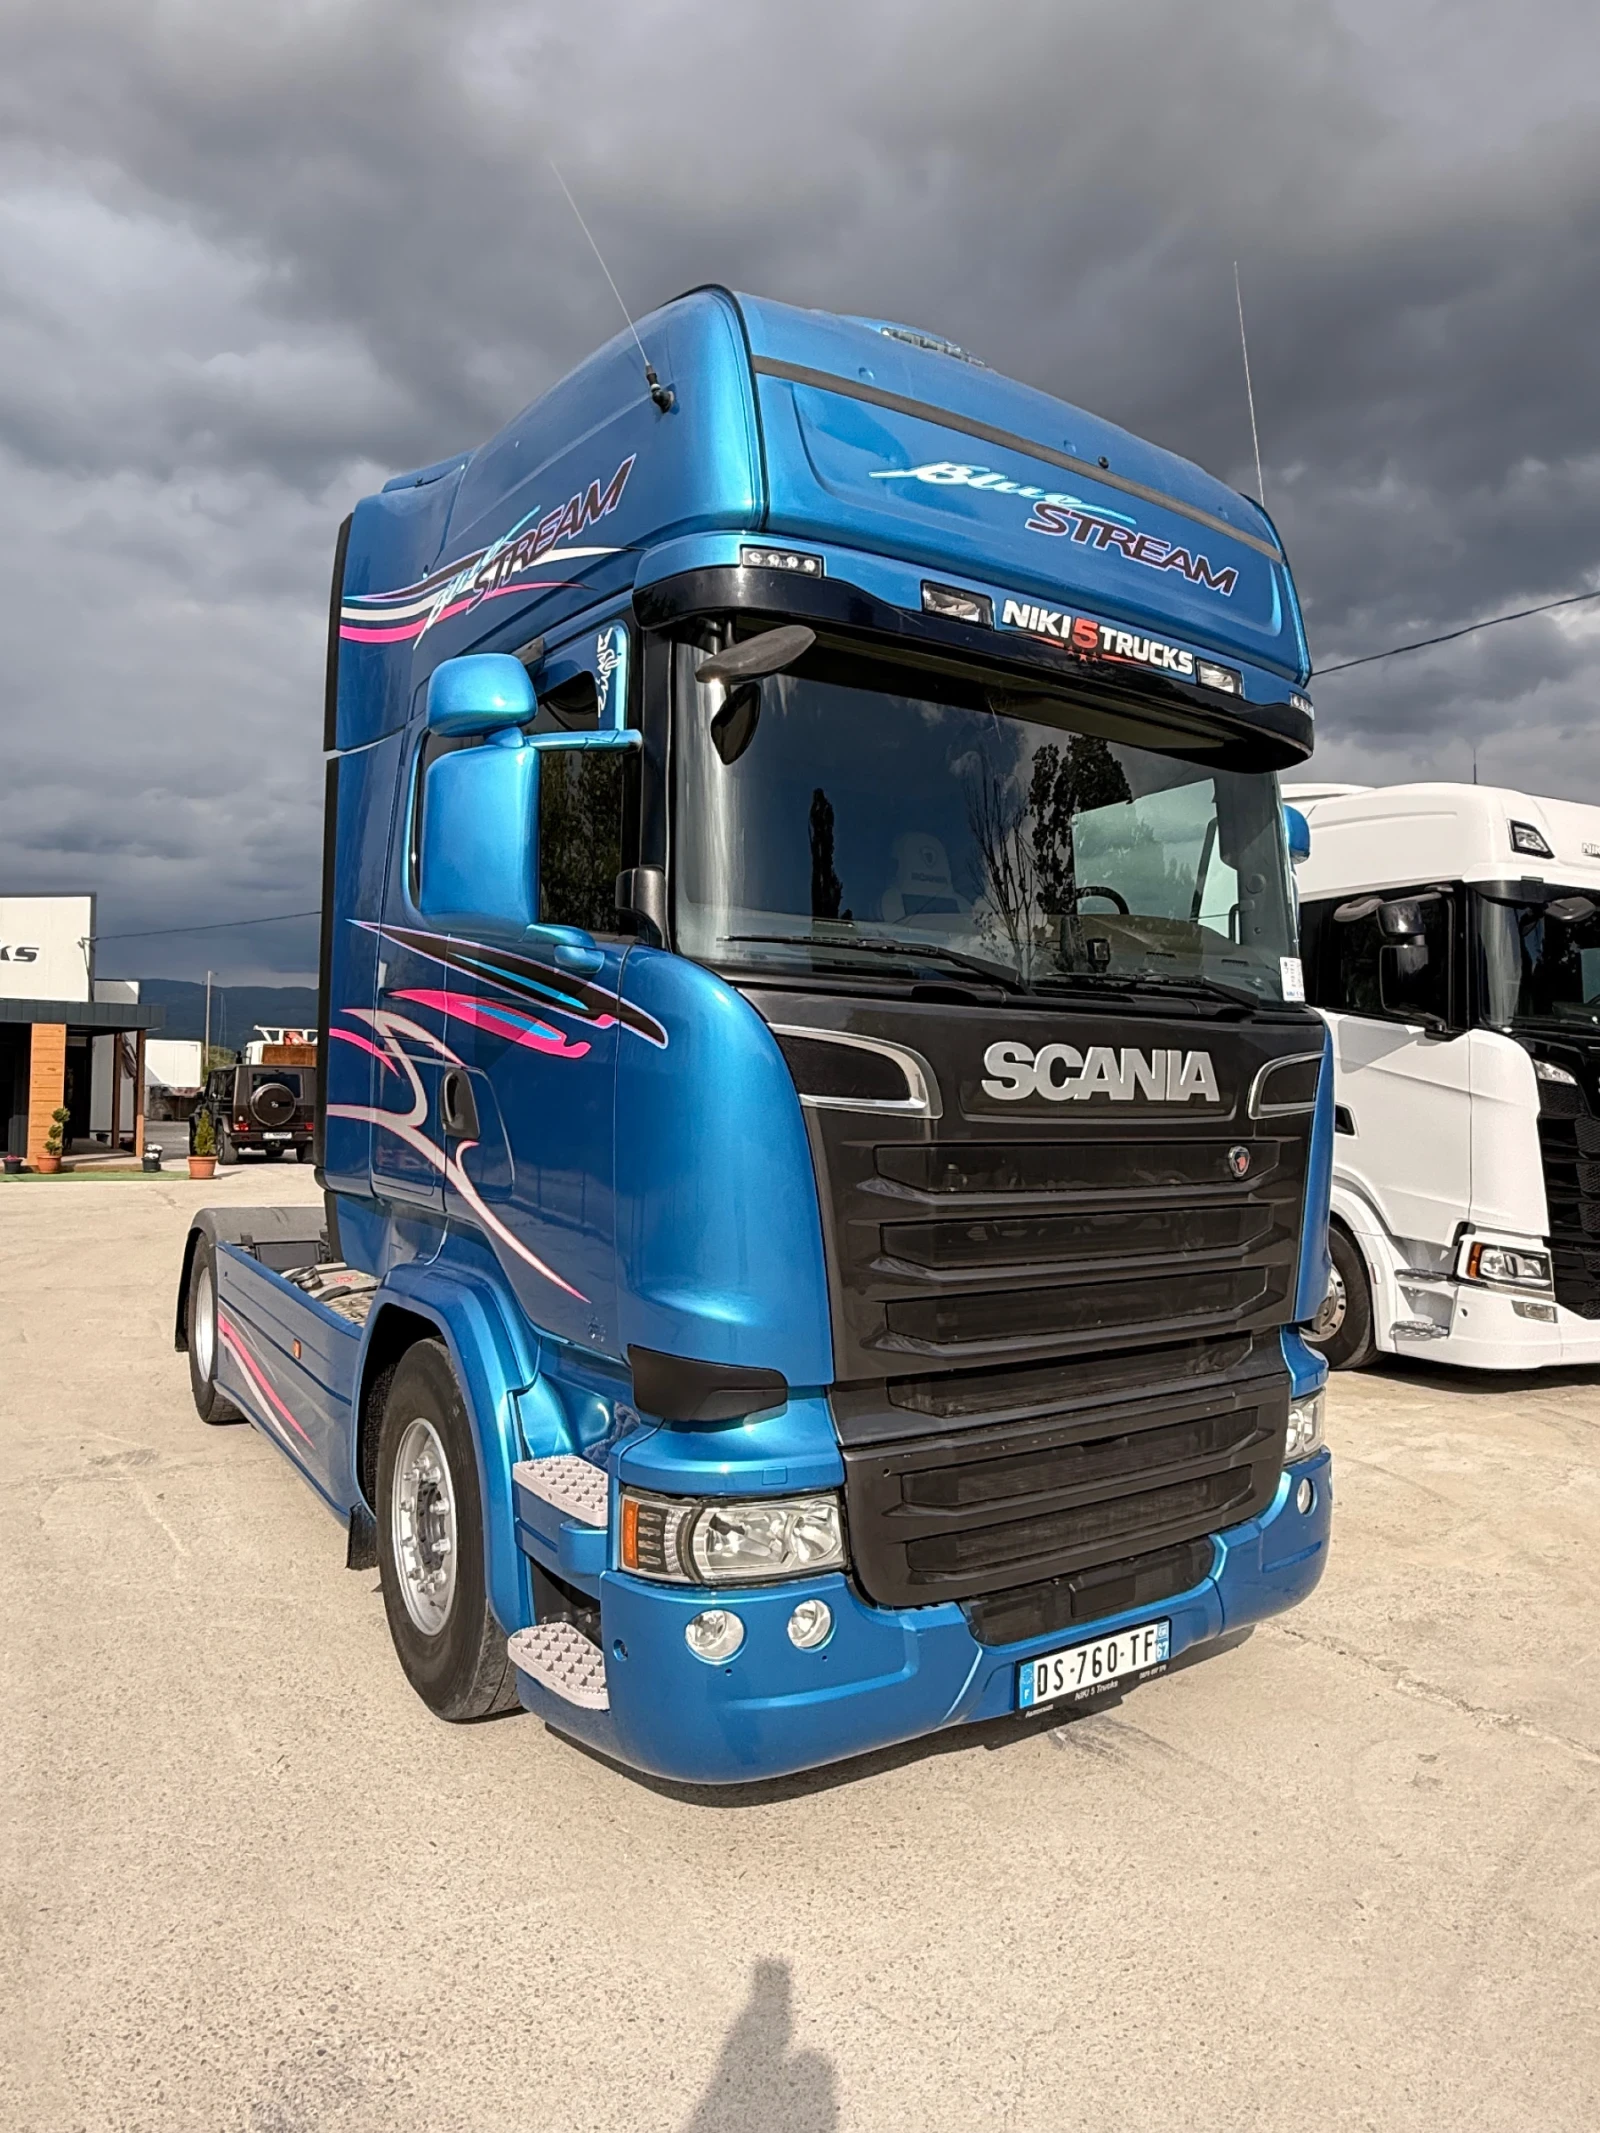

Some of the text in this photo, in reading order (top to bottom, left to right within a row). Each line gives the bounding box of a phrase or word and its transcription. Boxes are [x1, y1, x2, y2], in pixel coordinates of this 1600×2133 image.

[868, 461, 1137, 525] Blue
[466, 453, 637, 615] STREAM
[1024, 501, 1240, 597] STREAM
[1001, 599, 1072, 639] NIKI
[1099, 625, 1195, 676] TRUCKS
[981, 1041, 1221, 1102] SCANIA
[1156, 1640, 1169, 1659] 67
[1023, 1688, 1030, 1700] F
